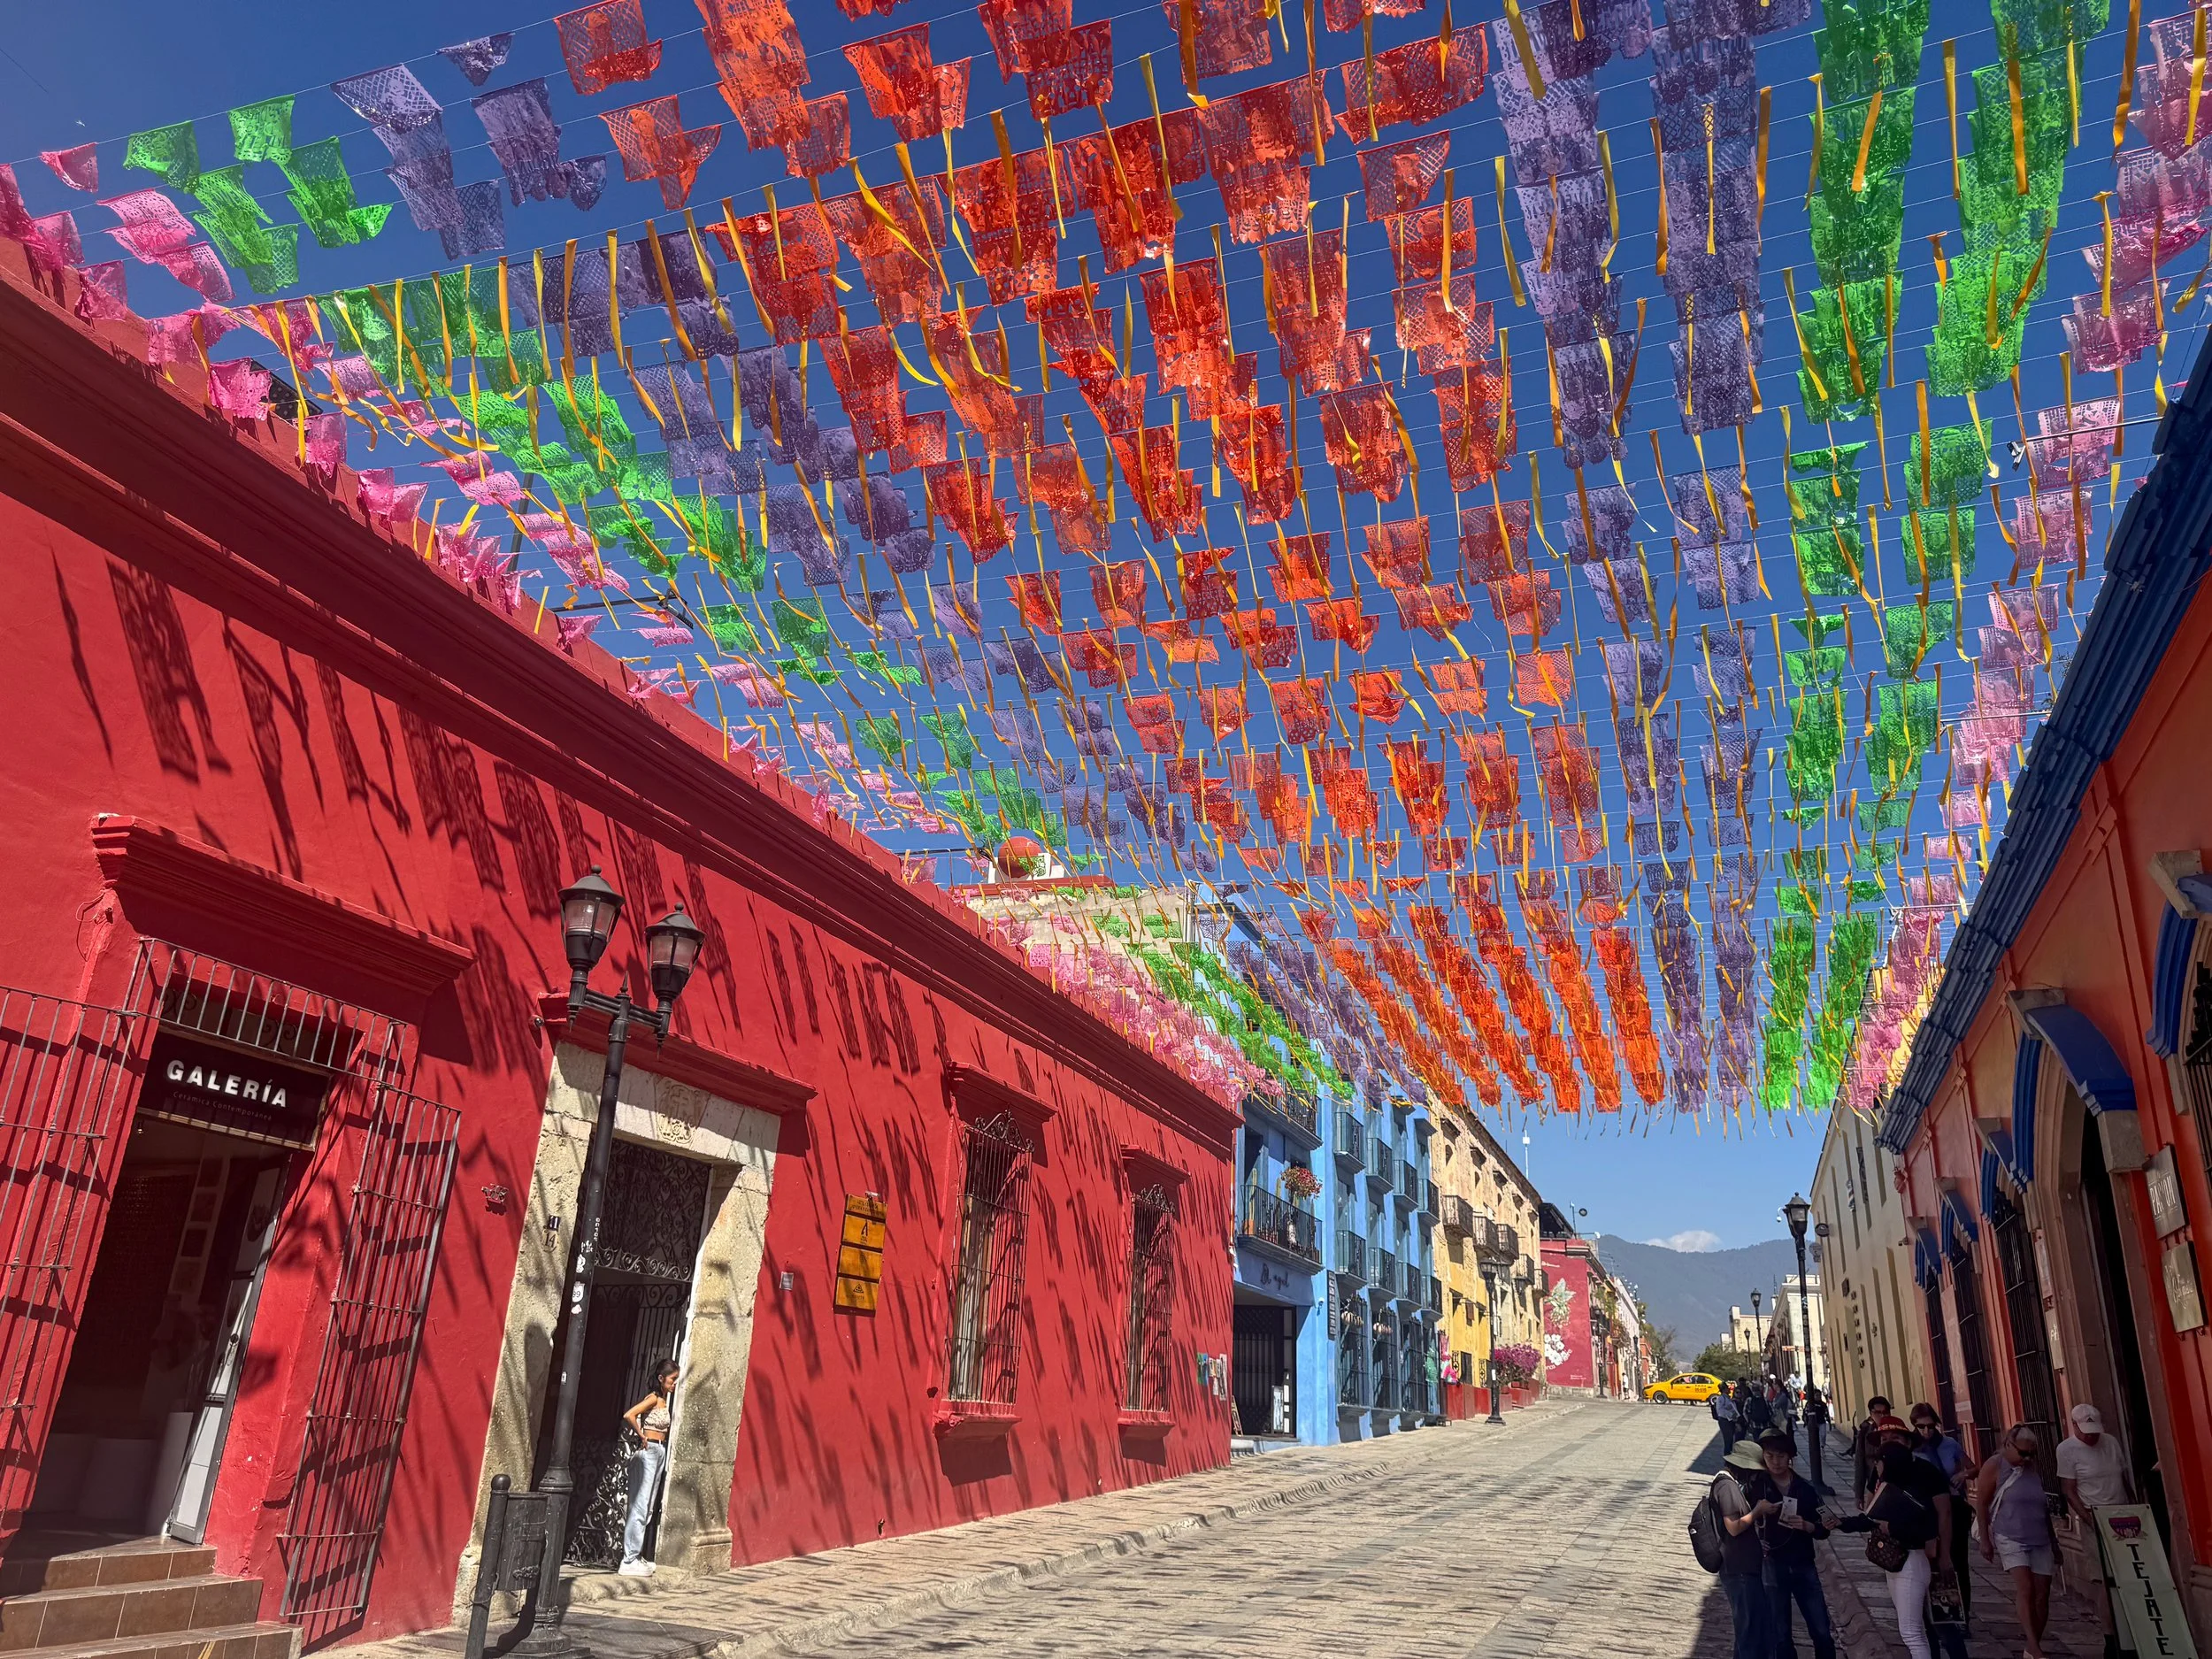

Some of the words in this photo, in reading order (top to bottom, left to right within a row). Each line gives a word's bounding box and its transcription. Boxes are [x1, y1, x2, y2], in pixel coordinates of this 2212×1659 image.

[166, 1060, 287, 1108] GALERÍA
[545, 1232, 557, 1248] 14
[2126, 1543, 2174, 1656] TEJATE
